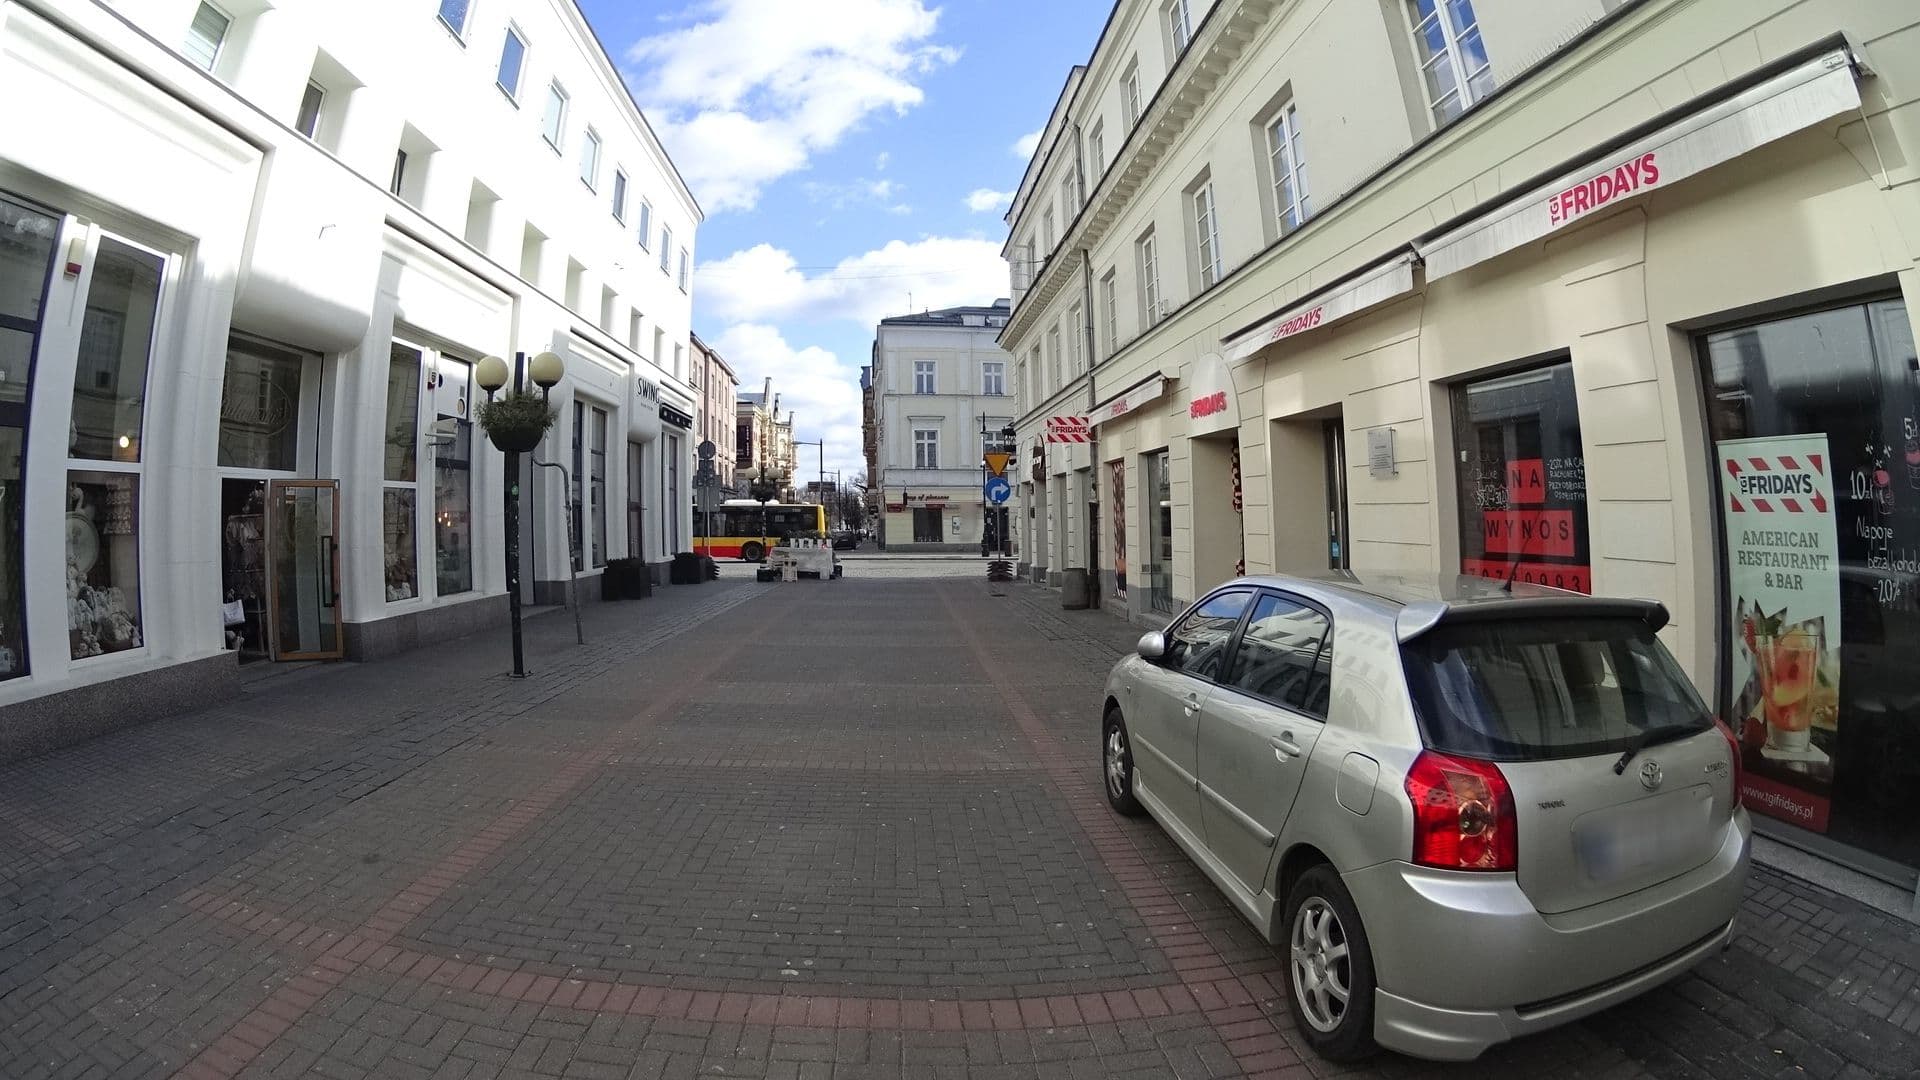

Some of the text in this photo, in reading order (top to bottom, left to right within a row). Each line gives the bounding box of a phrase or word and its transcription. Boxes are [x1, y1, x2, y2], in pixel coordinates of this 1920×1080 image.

[1549, 153, 1659, 226] TGI FRIDAYS
[1276, 306, 1322, 338] FRIDAYS
[637, 377, 660, 404] SWING
[1512, 468, 1540, 488] NA
[1749, 473, 1813, 495] FRIDAYS
[1486, 519, 1569, 540] WYNOS
[1742, 530, 1819, 549] AMERICAN
[1856, 515, 1894, 550] Napoje
[1738, 550, 1830, 571] RESTAURANT
[1764, 572, 1804, 591] & BAR
[1873, 576, 1901, 603] -20%
[1742, 784, 1814, 819] www.tgifridays.pl
